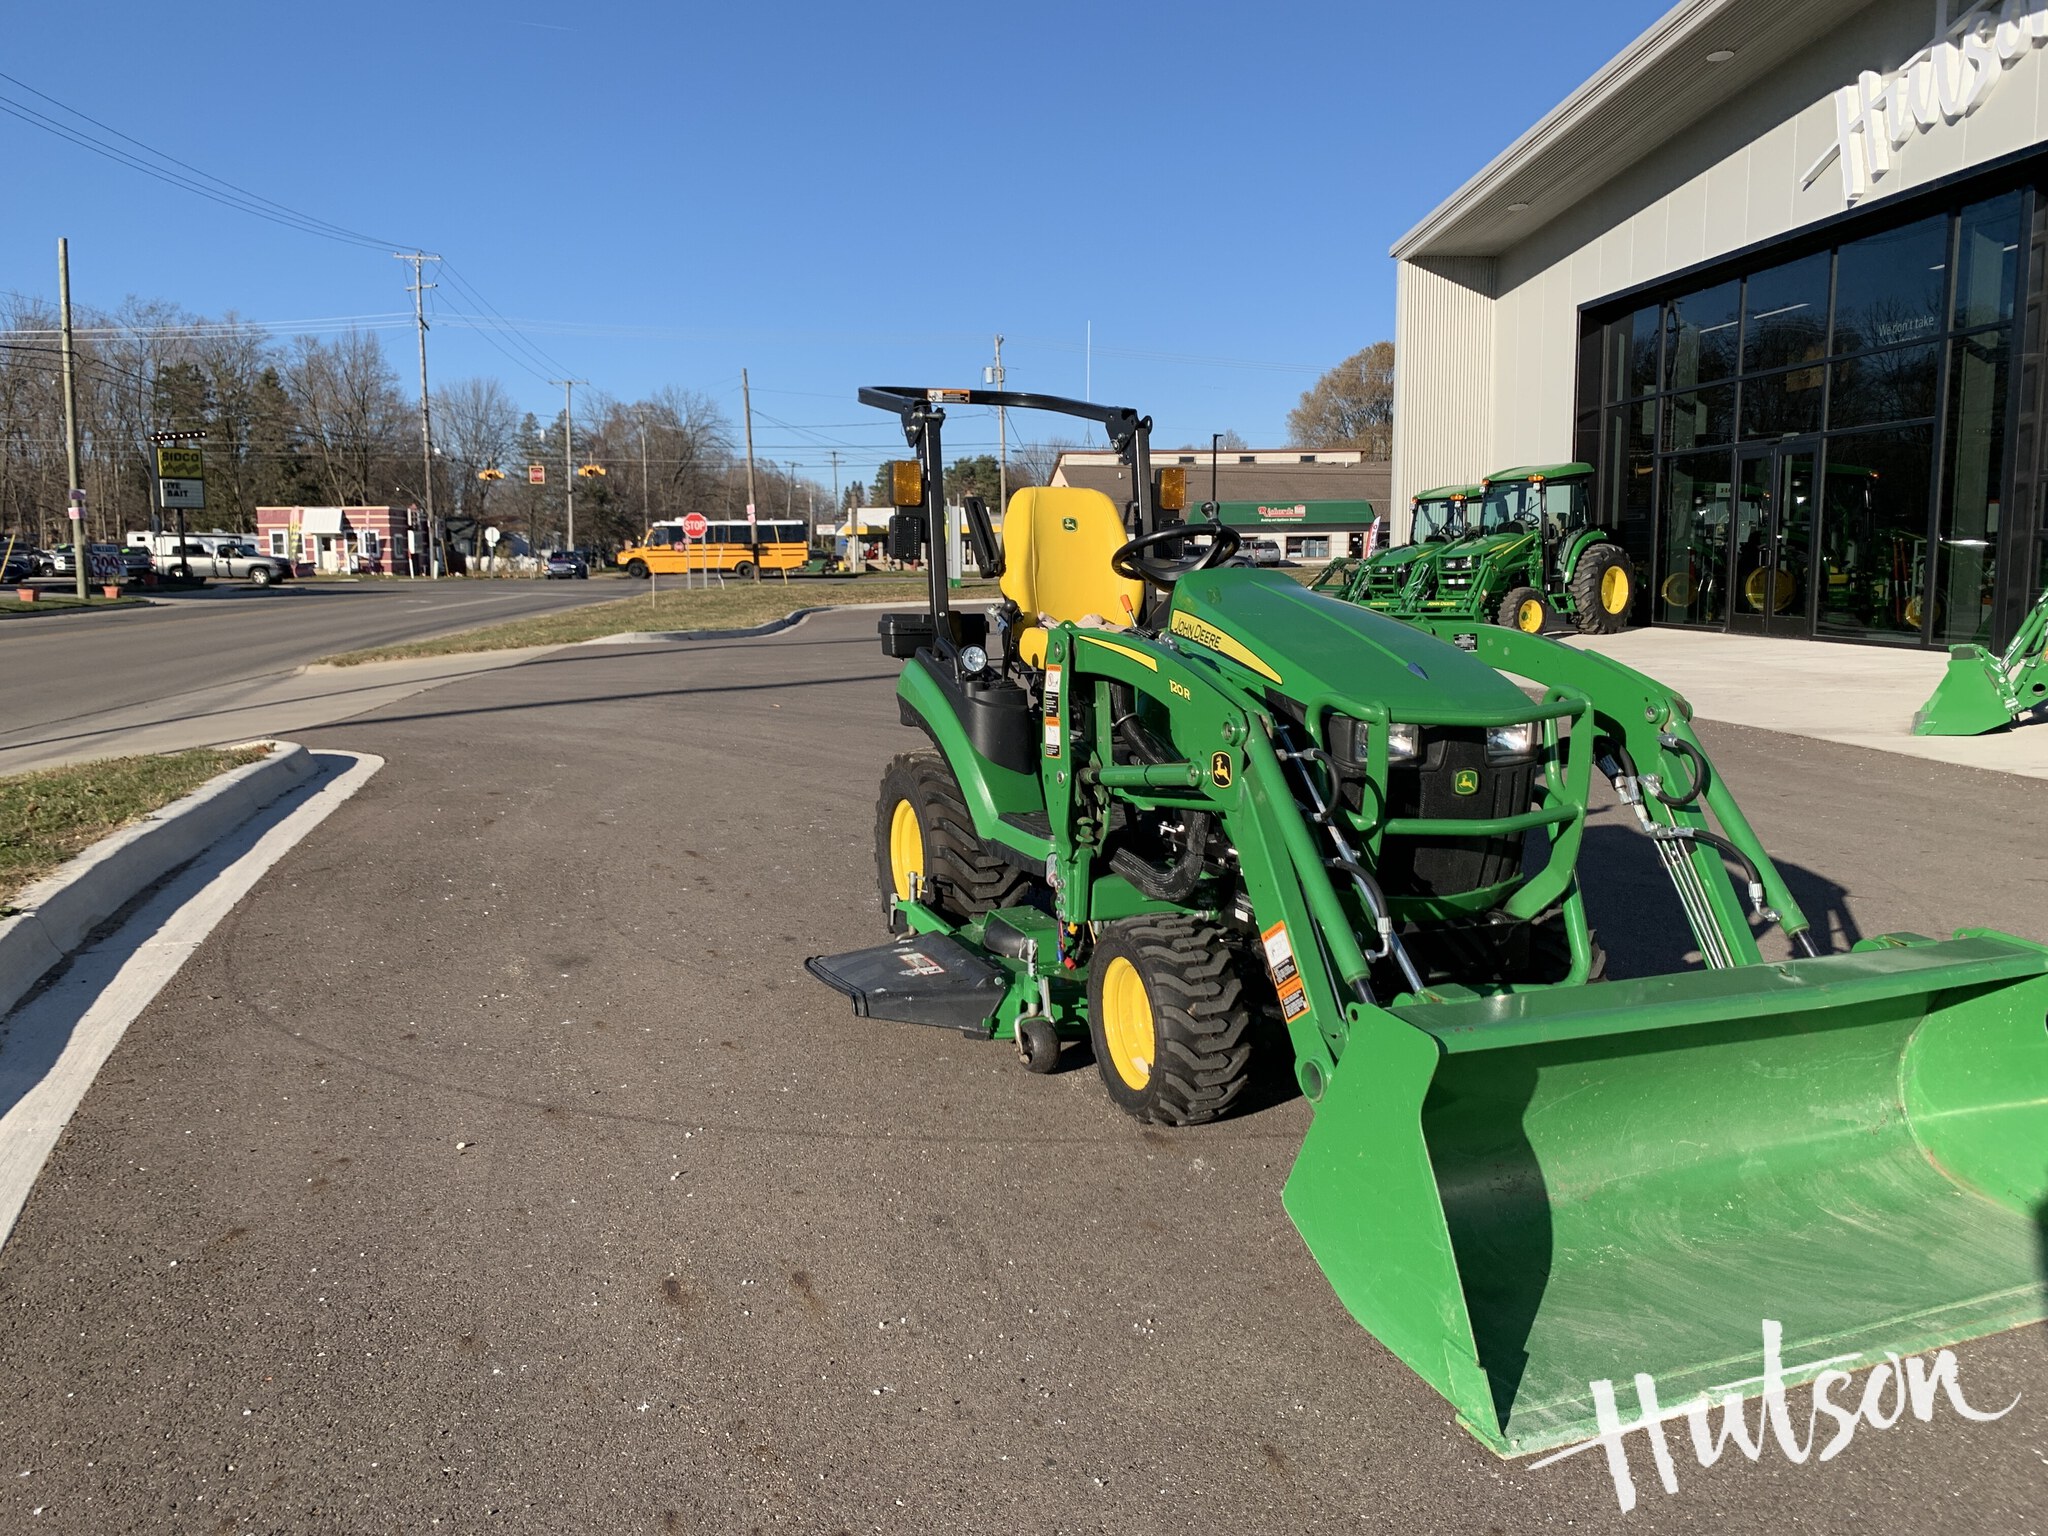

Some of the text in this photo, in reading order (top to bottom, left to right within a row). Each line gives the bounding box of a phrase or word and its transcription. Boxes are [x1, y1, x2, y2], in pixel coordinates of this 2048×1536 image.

[1915, 315, 1934, 329] take
[684, 521, 705, 531] STOP
[1174, 617, 1221, 648] JOHN DEERE
